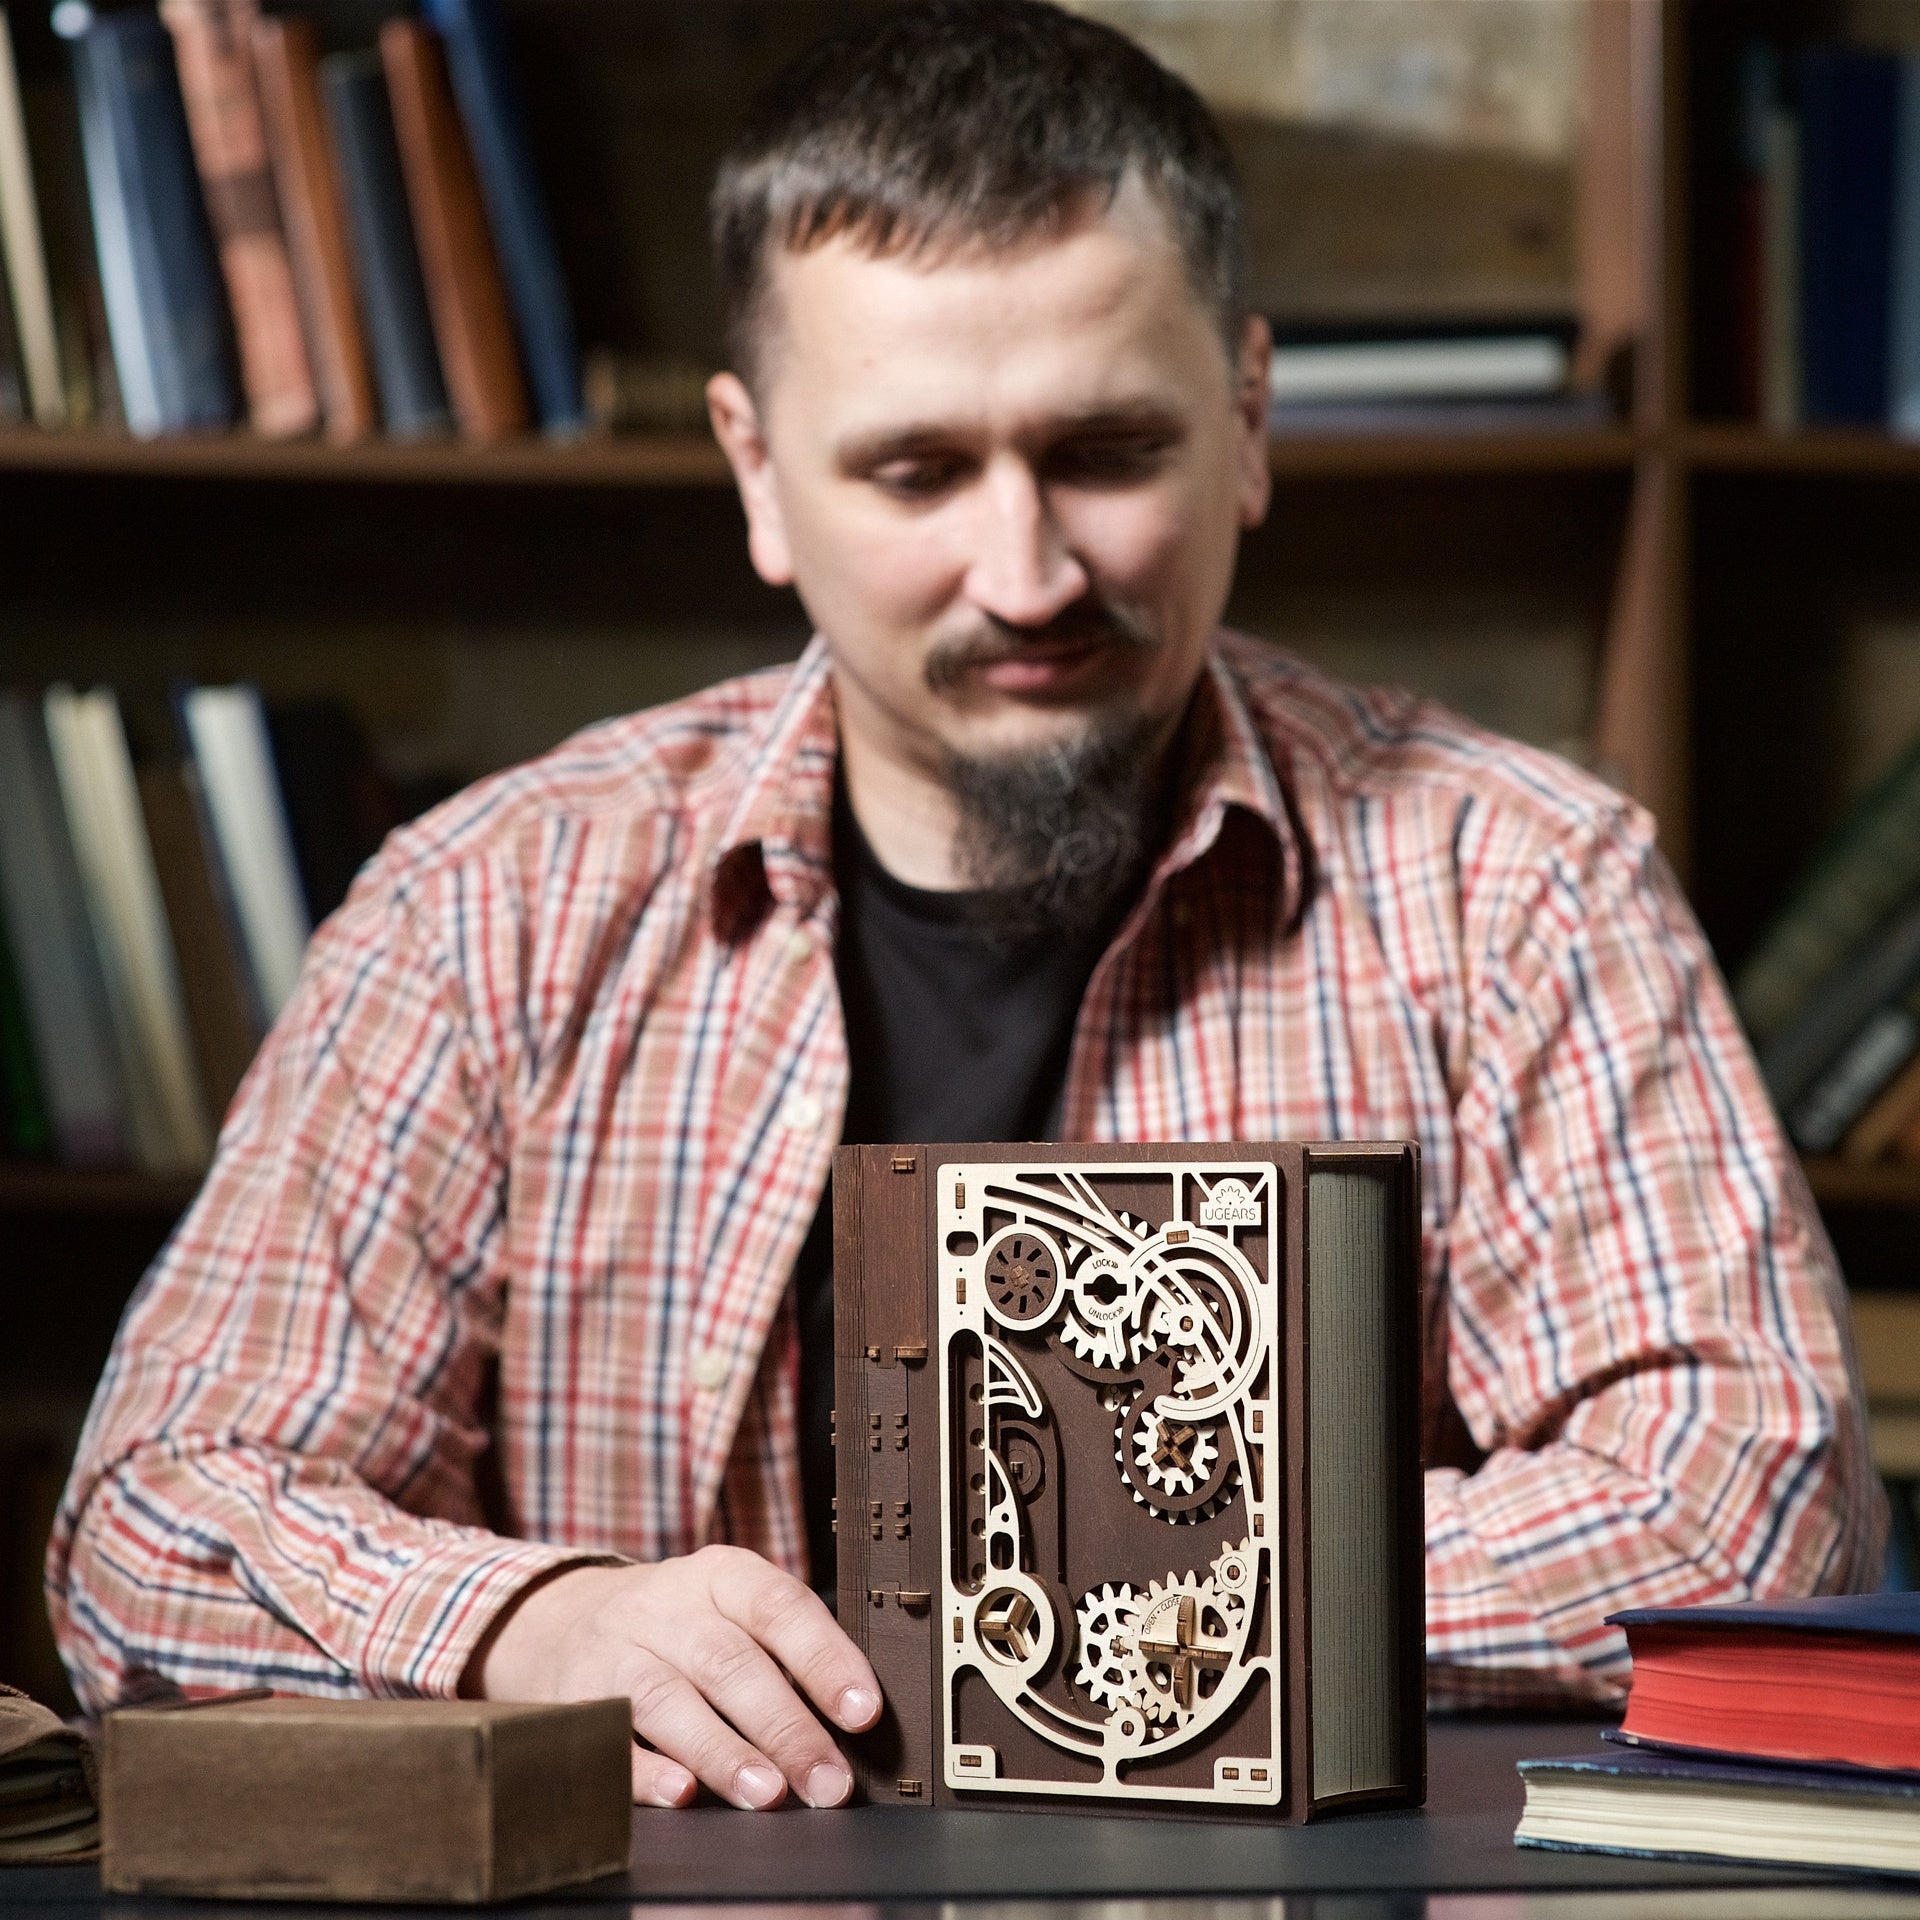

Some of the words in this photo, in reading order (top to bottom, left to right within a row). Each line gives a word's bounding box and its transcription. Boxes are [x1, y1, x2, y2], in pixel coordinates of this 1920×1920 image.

[1205, 1207, 1256, 1220] UGEARS
[1092, 1258, 1111, 1269] LOCK
[1088, 1307, 1118, 1320] UNLOCK
[1144, 1613, 1157, 1634] OPEN
[1160, 1597, 1180, 1611] CLOSE
